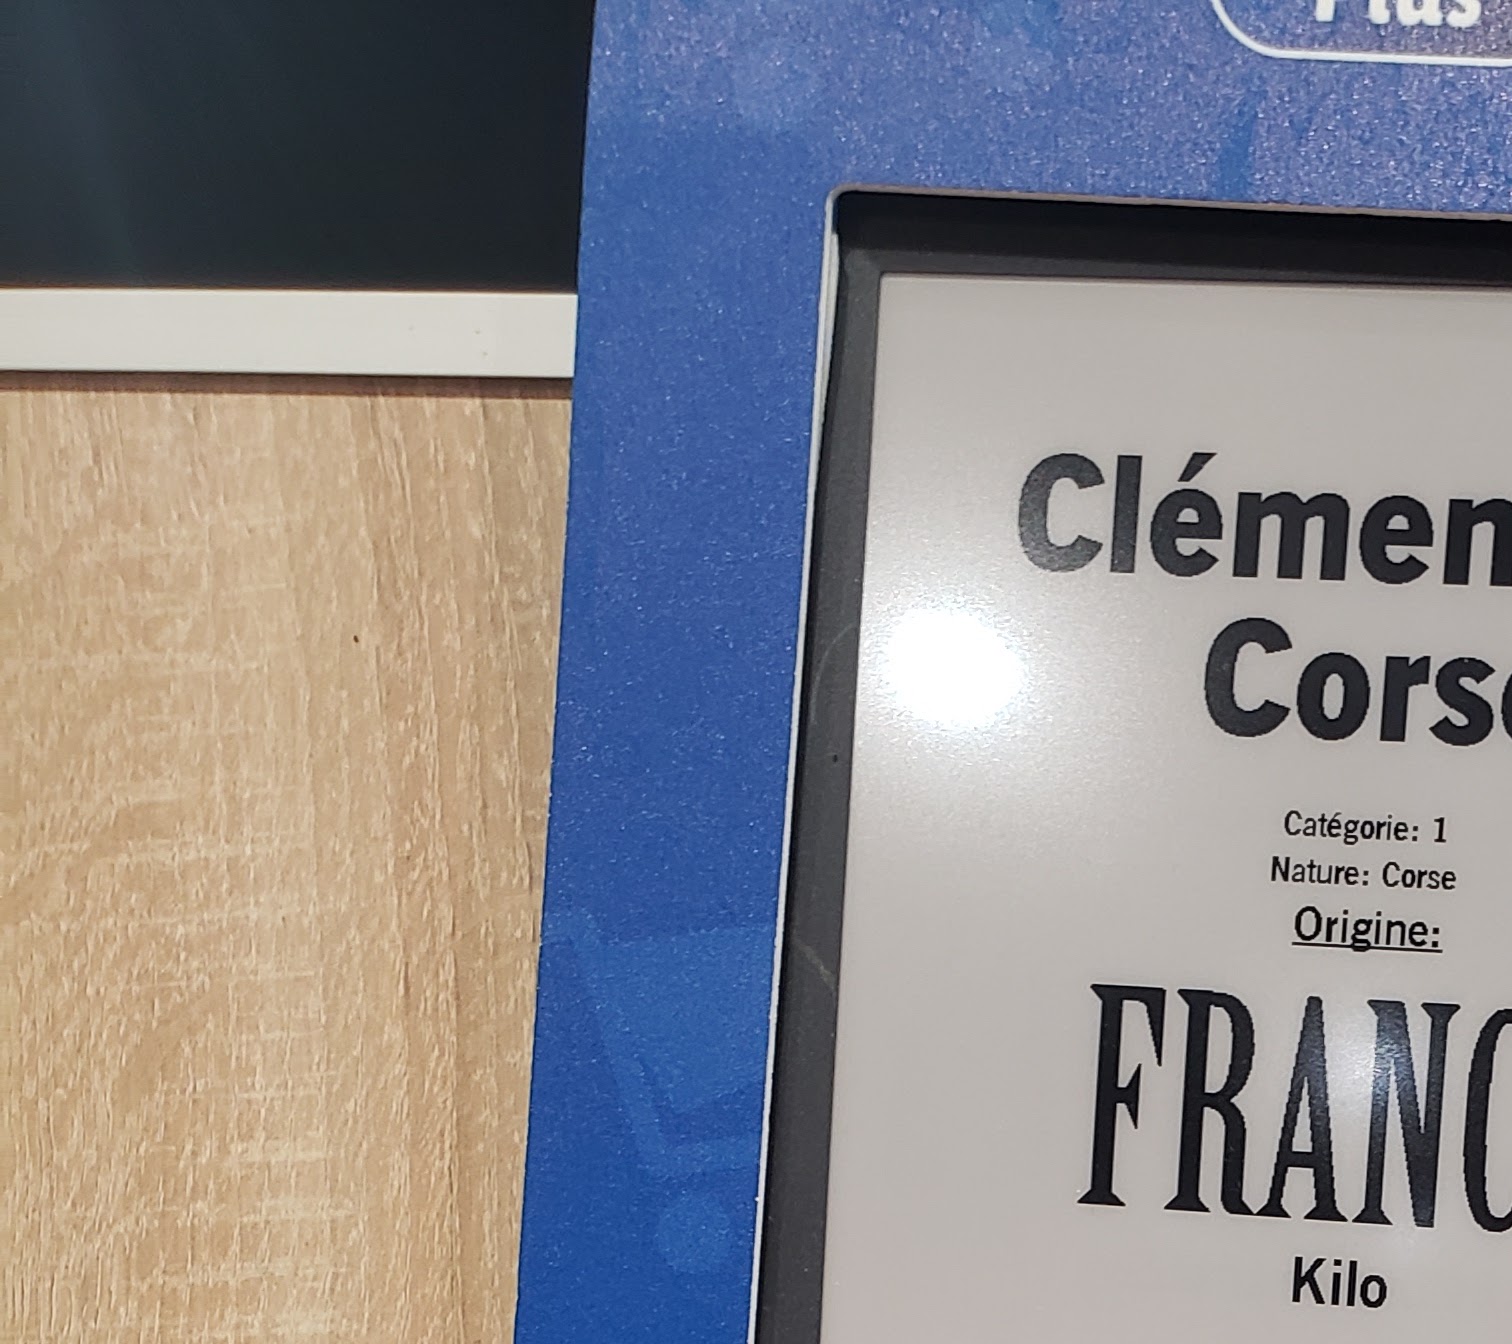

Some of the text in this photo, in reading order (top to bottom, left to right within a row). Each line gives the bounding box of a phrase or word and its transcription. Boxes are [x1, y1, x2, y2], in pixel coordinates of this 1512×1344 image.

[1284, 810, 1447, 846] Catégorie: 1
[1270, 856, 1457, 890] Nature: Corse
[1293, 905, 1442, 953] Origine:
[1291, 1255, 1388, 1308] Kilo
